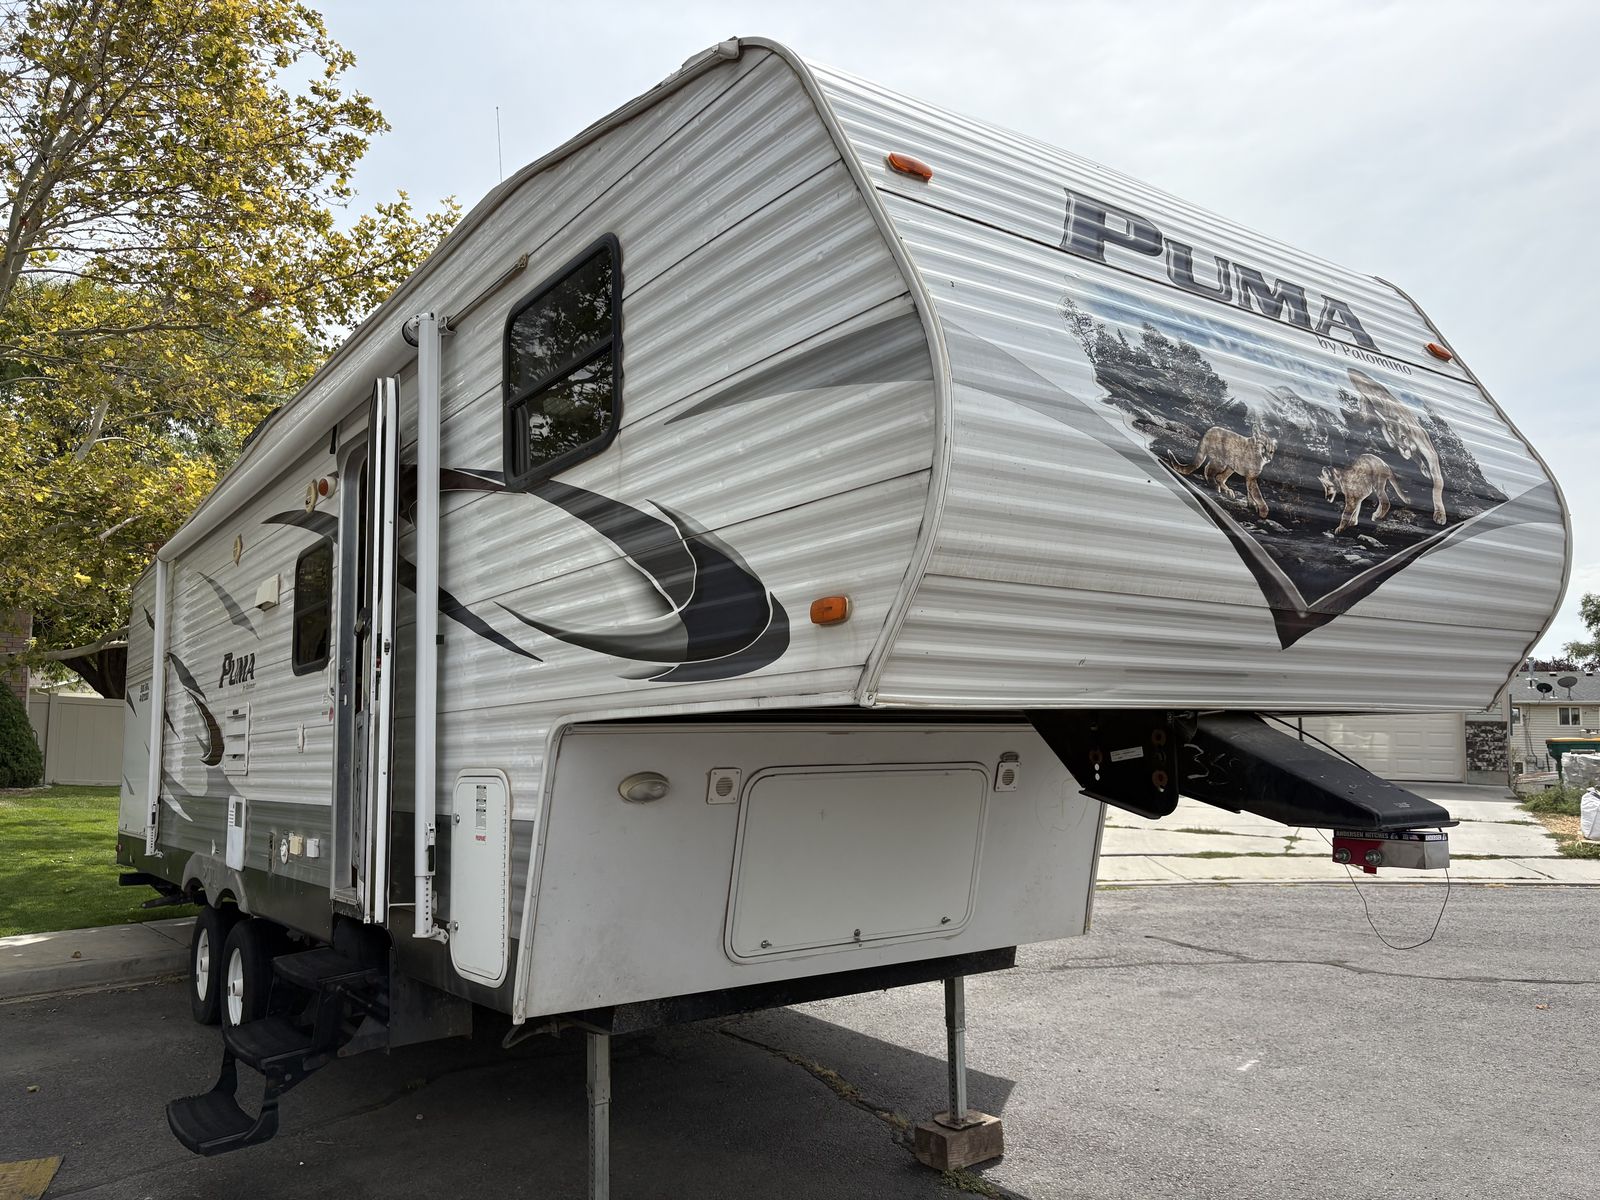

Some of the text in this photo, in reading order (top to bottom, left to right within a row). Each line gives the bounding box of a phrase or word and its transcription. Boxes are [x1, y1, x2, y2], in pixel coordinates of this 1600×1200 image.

[1059, 187, 1381, 352] PUMA
[1315, 335, 1412, 376] by Palomino
[219, 652, 255, 689] PUMA
